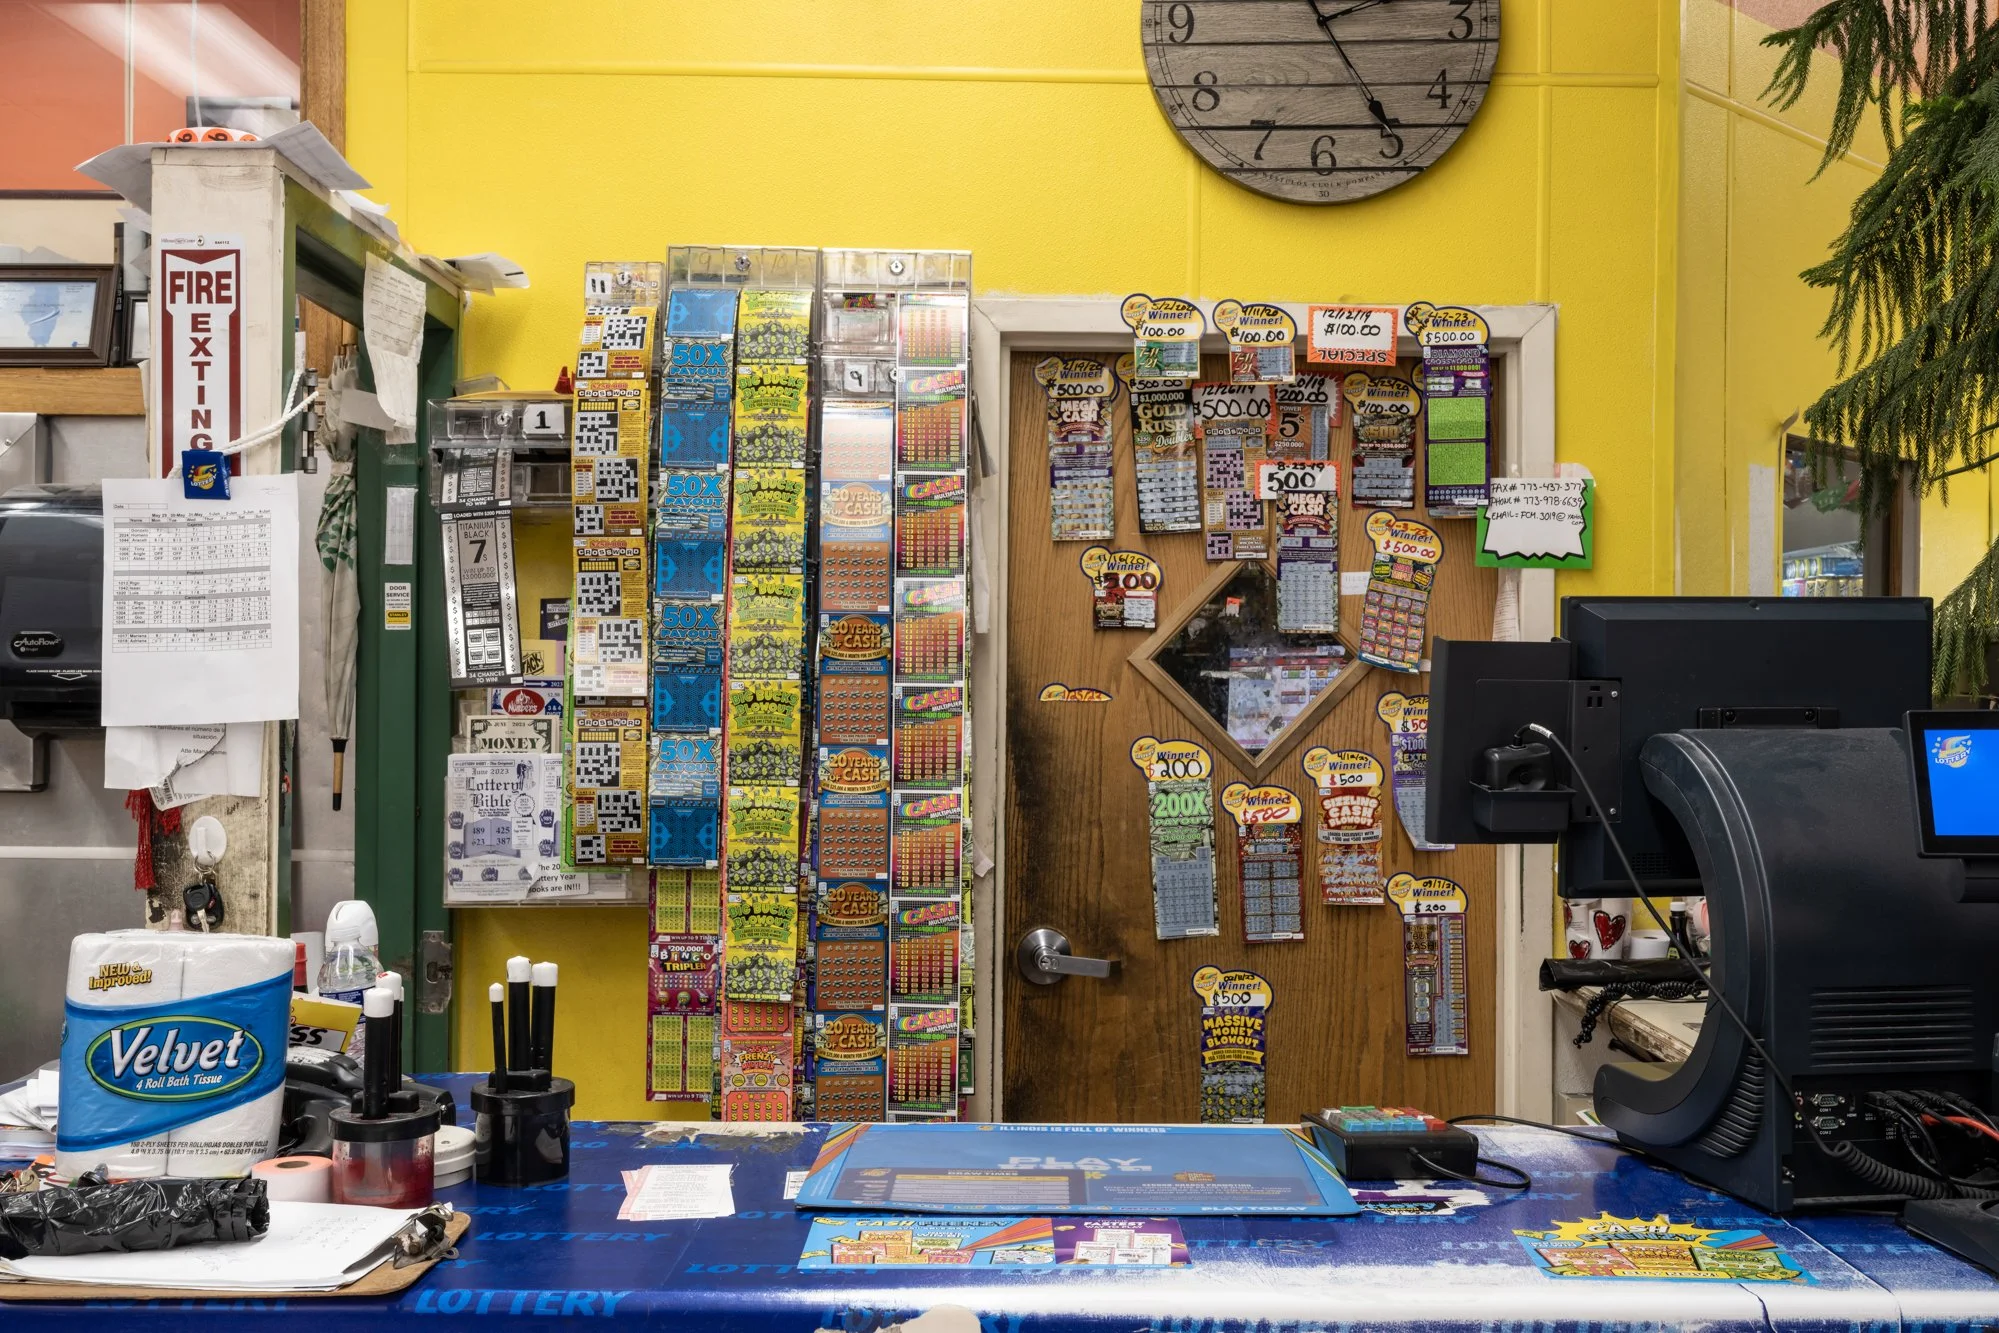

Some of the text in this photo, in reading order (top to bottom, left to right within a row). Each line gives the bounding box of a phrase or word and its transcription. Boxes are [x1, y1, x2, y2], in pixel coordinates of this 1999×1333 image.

[1168, 3, 1194, 43] 9
[1447, 1, 1474, 40] 3
[1192, 71, 1220, 112] 8
[1426, 69, 1452, 109] 4
[1250, 120, 1276, 160] 7
[1311, 135, 1336, 176] 6
[169, 271, 232, 304] FIRE
[1148, 310, 1193, 320] Winner!
[1239, 316, 1284, 326] Winner!
[1431, 317, 1477, 328] Winner!
[1425, 331, 1475, 344] $500.00
[1317, 349, 1387, 363] SPECIAL
[1431, 350, 1481, 358] DIAMOND
[1060, 370, 1103, 380] Winner!
[578, 389, 641, 397] CROSSWORD
[1140, 392, 1184, 402] $1,000,000
[1367, 387, 1409, 398] Winner!
[1060, 400, 1099, 412] MEGA
[1138, 403, 1187, 419] GOLD
[534, 411, 551, 429] 1
[1062, 411, 1098, 423] CASH
[1138, 419, 1188, 432] RUSH
[1206, 427, 1262, 435] CROSSWORD
[1155, 431, 1194, 448] Doubler
[1267, 472, 1316, 492] 500
[665, 497, 725, 507] PAYOUT
[1287, 493, 1326, 505] MEGA
[1289, 504, 1324, 516] CASH
[464, 530, 490, 538] BLACK
[1390, 528, 1434, 543] Winner!
[577, 548, 640, 556] CROSSWORD
[1107, 561, 1150, 571] Winner!
[662, 605, 720, 629] 50X
[661, 629, 720, 639] PAYOUT
[732, 689, 798, 705] BIG BUCKS
[736, 702, 793, 715] BLOWOUT
[481, 737, 540, 749] MONEY
[659, 739, 717, 763] 50X
[1156, 750, 1200, 760] Winner!
[1935, 748, 1971, 765] LOTTERY
[849, 757, 880, 769] YEARS
[1328, 760, 1372, 770] Winner!
[830, 774, 841, 782] OF
[465, 777, 521, 793] Lottery
[470, 793, 512, 808] Bible
[1153, 790, 1210, 817] 200X
[1322, 794, 1380, 810] SIZZLING
[1328, 806, 1375, 818] CASH
[1153, 818, 1210, 826] PAYOUT
[1328, 816, 1374, 828] BLOWOUT
[495, 837, 511, 845] 387
[564, 883, 581, 891] IN!!!
[1412, 888, 1455, 897] Winner!
[828, 888, 845, 902] 20
[728, 902, 796, 918] BIG BUCKS
[841, 902, 878, 915] CASH
[906, 902, 957, 925] CASH
[732, 915, 791, 927] BLOWOUT
[1406, 942, 1438, 951] CASH!
[660, 950, 711, 961] BINGO
[99, 961, 142, 977] NEW &
[664, 962, 706, 971] TRIPLER
[89, 970, 152, 991] Improved!
[1217, 981, 1262, 991] Winner!
[1212, 988, 1252, 1006] $500
[905, 1009, 955, 1031] CASH
[1203, 1014, 1263, 1031] MASSIVE
[825, 1021, 876, 1035] 20 YEARS
[1212, 1027, 1254, 1037] MONEY
[826, 1035, 876, 1049] OF CASH
[1205, 1036, 1259, 1048] BLOWOUT
[110, 1027, 246, 1078] Velvet
[740, 1052, 776, 1062] FRENZY
[136, 1074, 222, 1090] 4 Roll Bath Tissue
[1586, 1224, 1670, 1234] CASH
[477, 1232, 671, 1242] LOTTERY
[1577, 1233, 1702, 1242] FRENZY
[415, 1289, 632, 1317] LOTTERY
